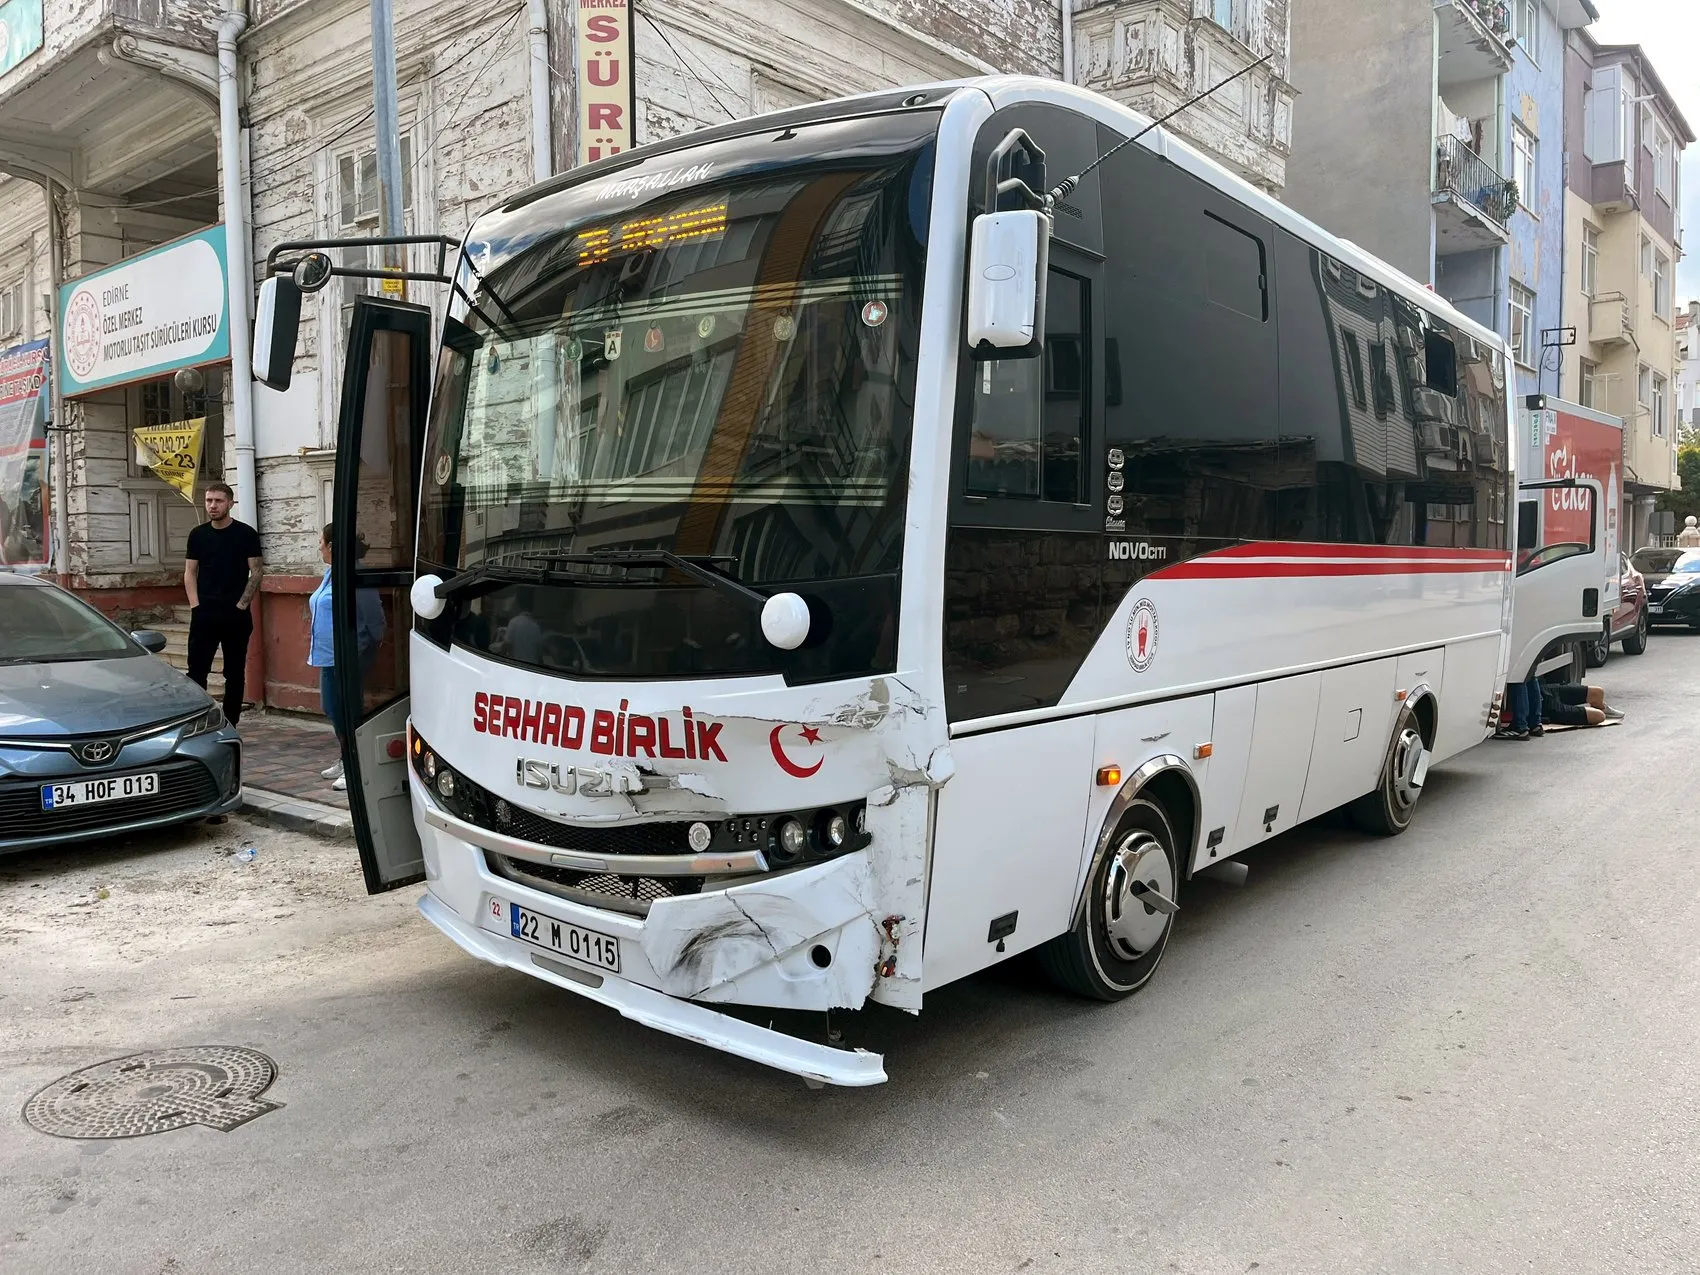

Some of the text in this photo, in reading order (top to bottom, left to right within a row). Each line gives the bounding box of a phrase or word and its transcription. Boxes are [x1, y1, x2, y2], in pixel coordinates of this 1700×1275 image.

[103, 284, 129, 307] EDİRNE
[103, 307, 143, 335] ÖZEL MERKEZ
[104, 313, 217, 361] MOTORLU TAŞIT SÜRÜCÜLERİ KURSU
[608, 340, 617, 354] A
[160, 435, 175, 453] 242
[174, 453, 196, 469] 23
[473, 691, 729, 763] SERHAD BİRLİK
[54, 785, 76, 804] 34
[85, 781, 117, 801] HOF
[123, 775, 155, 795] 013
[491, 901, 501, 917] 22
[513, 912, 615, 966] TR 22 M 0115
